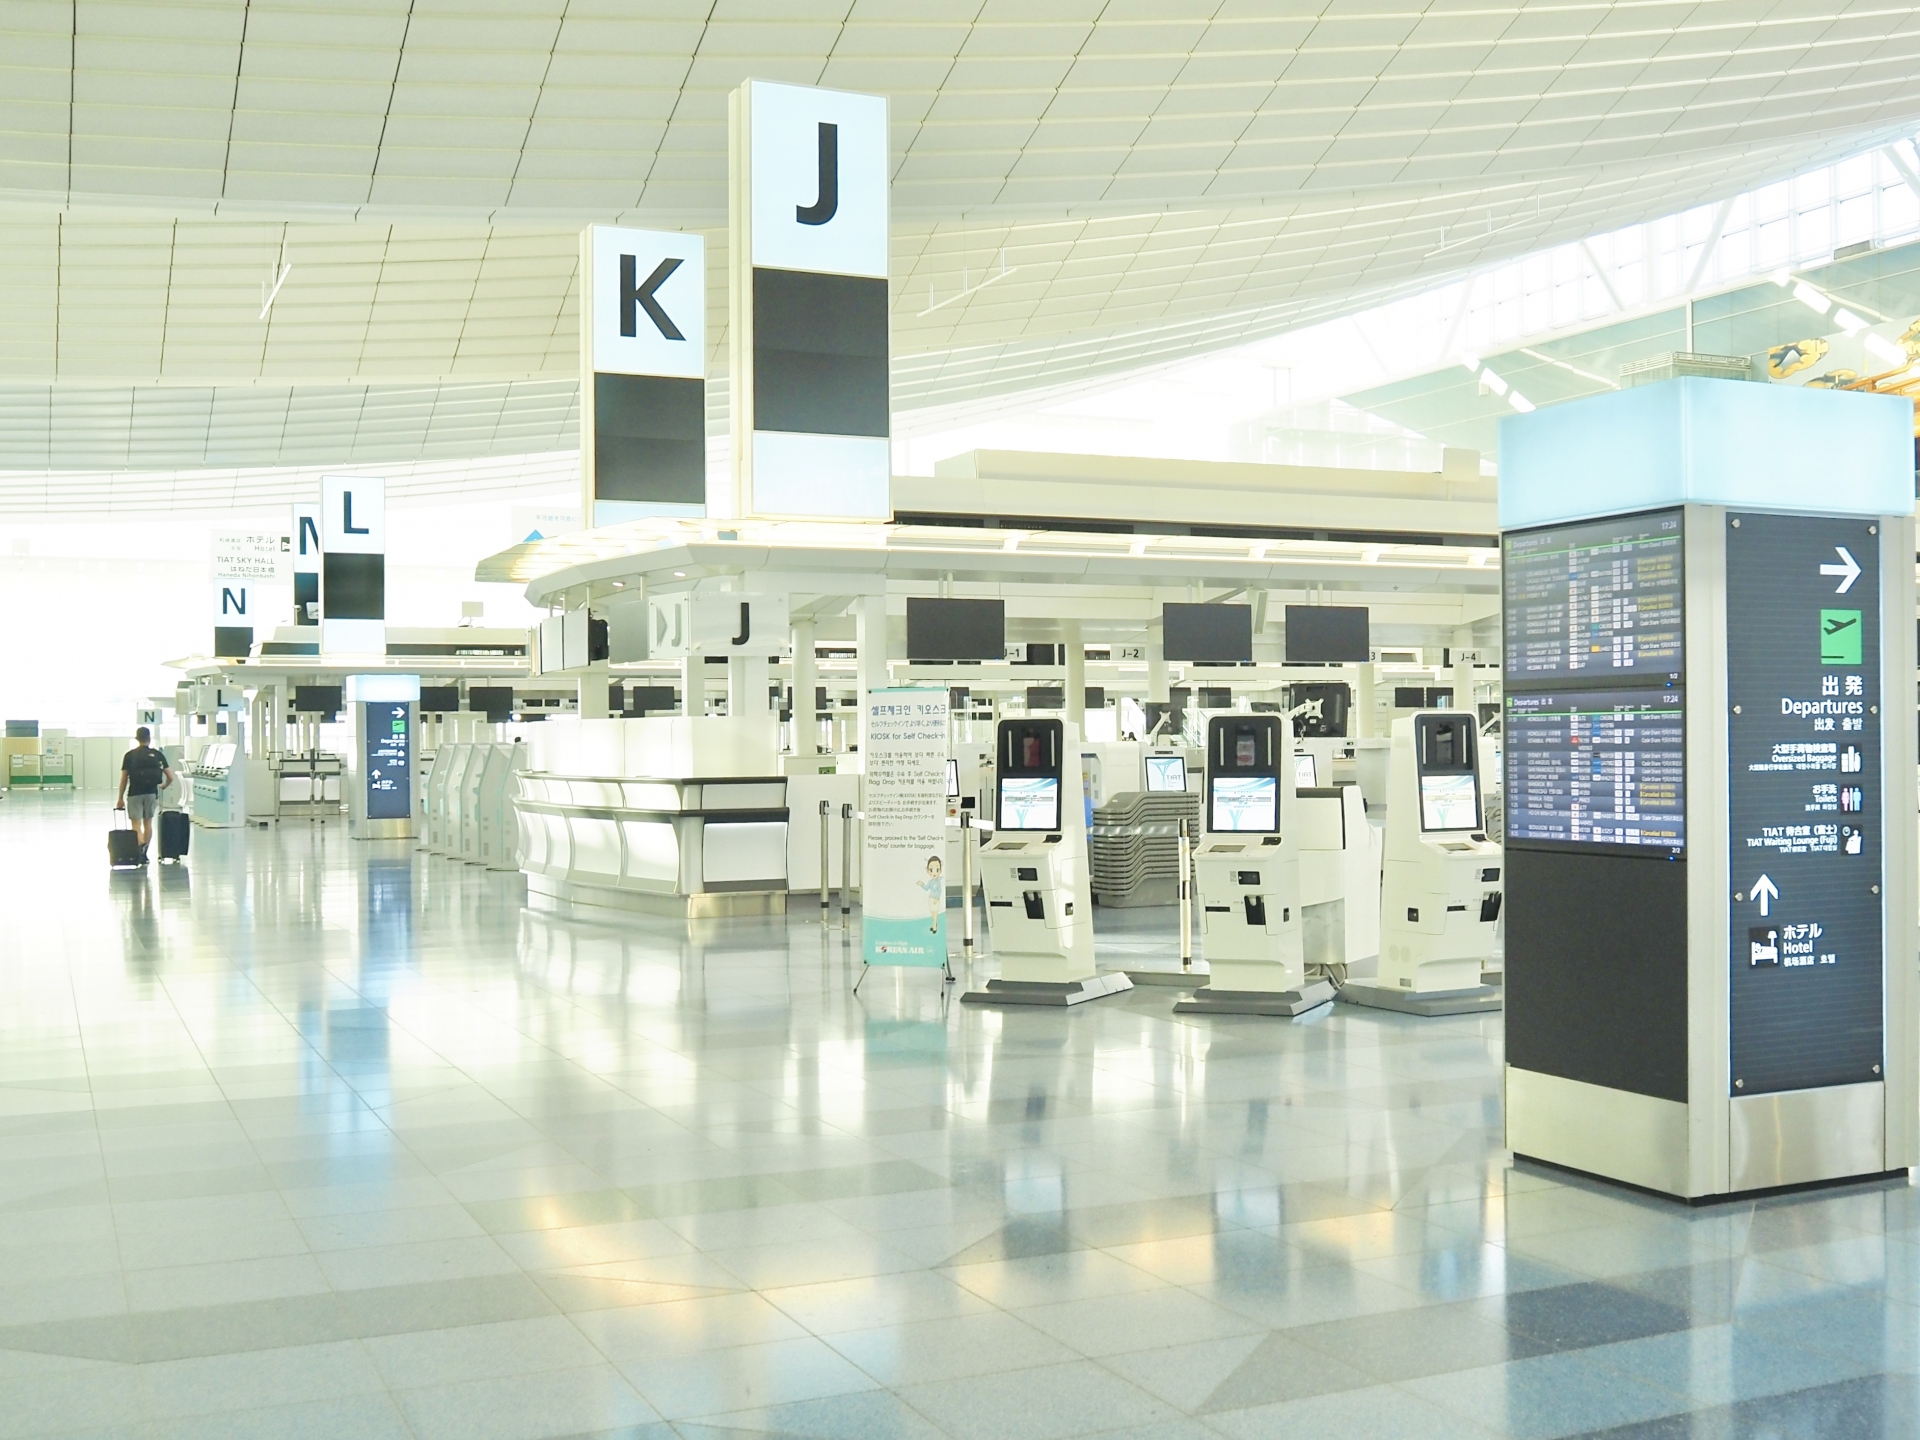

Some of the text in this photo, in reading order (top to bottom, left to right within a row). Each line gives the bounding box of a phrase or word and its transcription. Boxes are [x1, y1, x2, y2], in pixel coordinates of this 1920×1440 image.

[796, 121, 838, 226] J
[620, 254, 687, 341] K
[344, 490, 370, 534] L
[1661, 520, 1676, 530] 17:24
[246, 536, 274, 544] ホテル
[217, 556, 234, 564] TIAT
[222, 588, 246, 614] N
[732, 602, 750, 645] J
[1122, 649, 1139, 658] J-2
[1462, 653, 1476, 661] J-4
[217, 690, 228, 707] L
[871, 704, 946, 716] 셀프체크인 키오스크
[1782, 698, 1863, 718] Departures
[145, 712, 154, 722] N
[1772, 754, 1837, 764] Oversized Baggage
[1814, 794, 1837, 803] Toilets
[1762, 827, 1784, 837] TIAT
[1746, 835, 1838, 848] TIAT Waiting Lounge (Fuji)
[1784, 923, 1822, 939] ホテル
[1784, 940, 1813, 954] Hotel
[1820, 954, 1835, 964] 호텔
